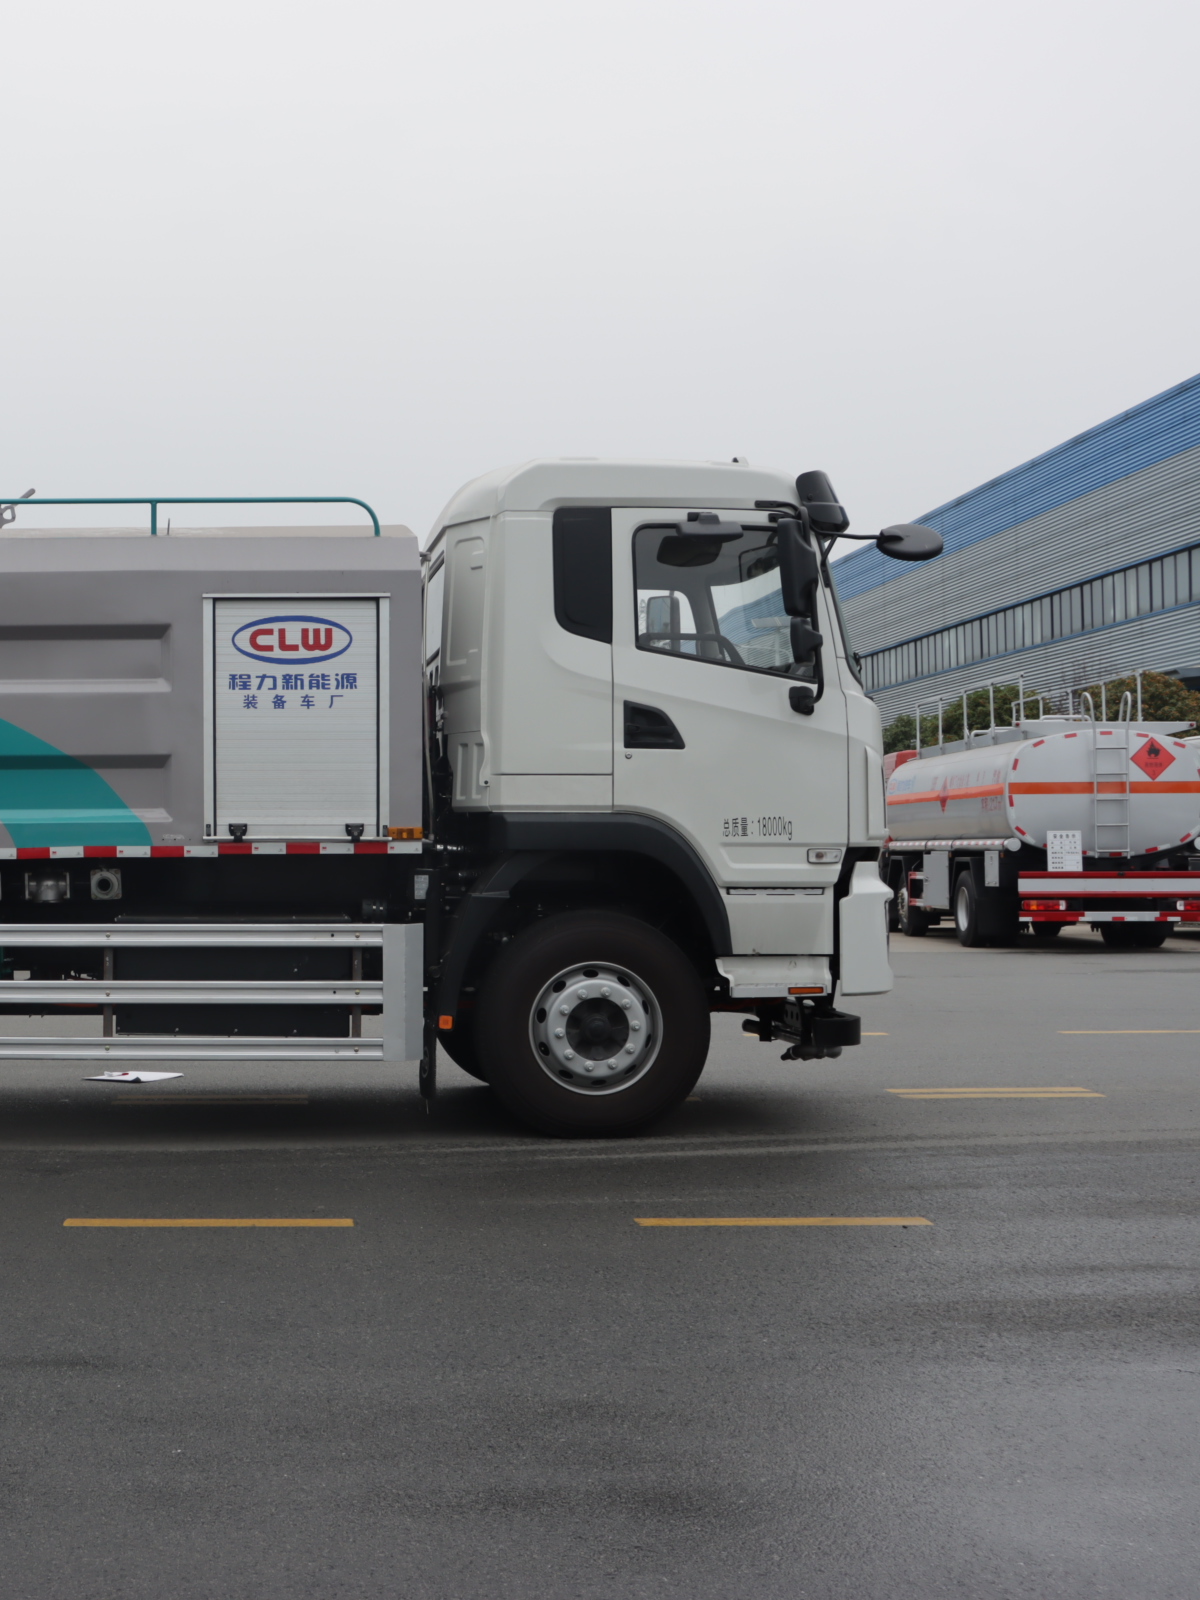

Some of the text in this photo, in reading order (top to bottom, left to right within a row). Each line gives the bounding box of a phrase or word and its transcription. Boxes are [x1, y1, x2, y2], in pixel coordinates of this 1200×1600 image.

[249, 627, 333, 652] CLW
[228, 672, 358, 691] 程力新能源
[243, 694, 344, 710] 装备车厂
